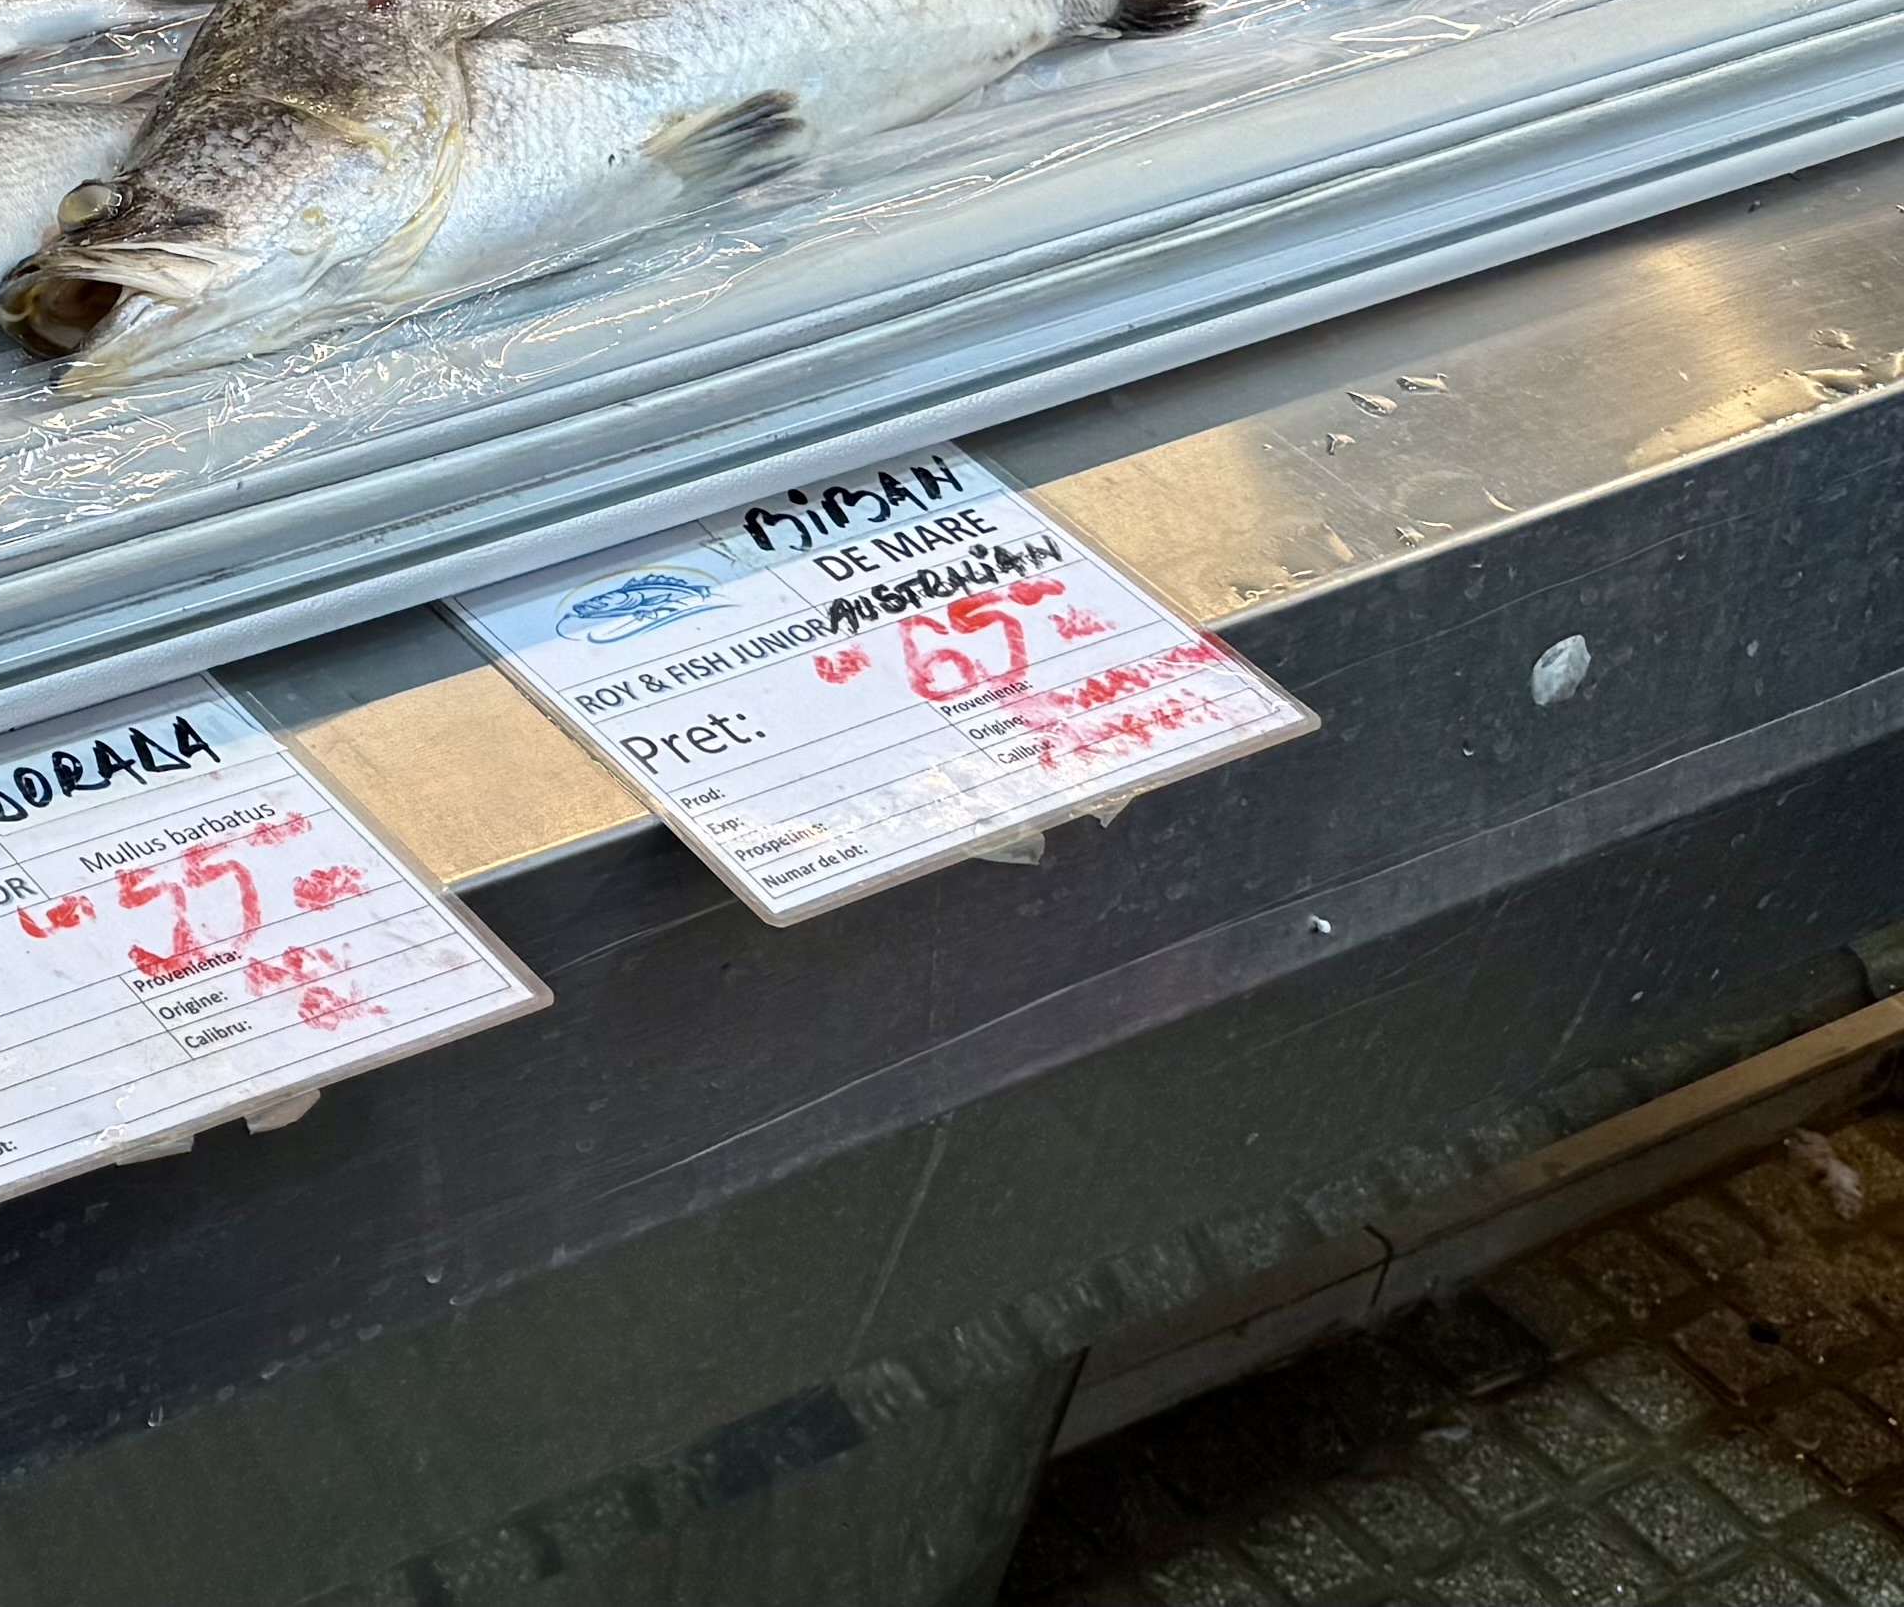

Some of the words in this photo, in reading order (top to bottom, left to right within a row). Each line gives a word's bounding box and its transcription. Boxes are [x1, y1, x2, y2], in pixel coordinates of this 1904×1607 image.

[813, 546, 880, 582] DE
[871, 508, 998, 563] MARE
[575, 681, 639, 715] ROY
[638, 673, 672, 693] &
[665, 651, 735, 686] FISH
[729, 617, 833, 664] JUNIOR
[940, 679, 1033, 717] Provenienta:
[619, 713, 766, 775] Pret:
[680, 786, 726, 810] Prod:
[79, 834, 168, 874] Mullus
[164, 800, 277, 846] barbatus
[706, 816, 745, 836] Exp:
[761, 861, 815, 889] Numar
[817, 853, 840, 868] de
[836, 843, 869, 861] lot:
[133, 949, 242, 993] Provenienta:
[158, 991, 228, 1021] Origine:
[184, 1020, 252, 1050] Calibru:
